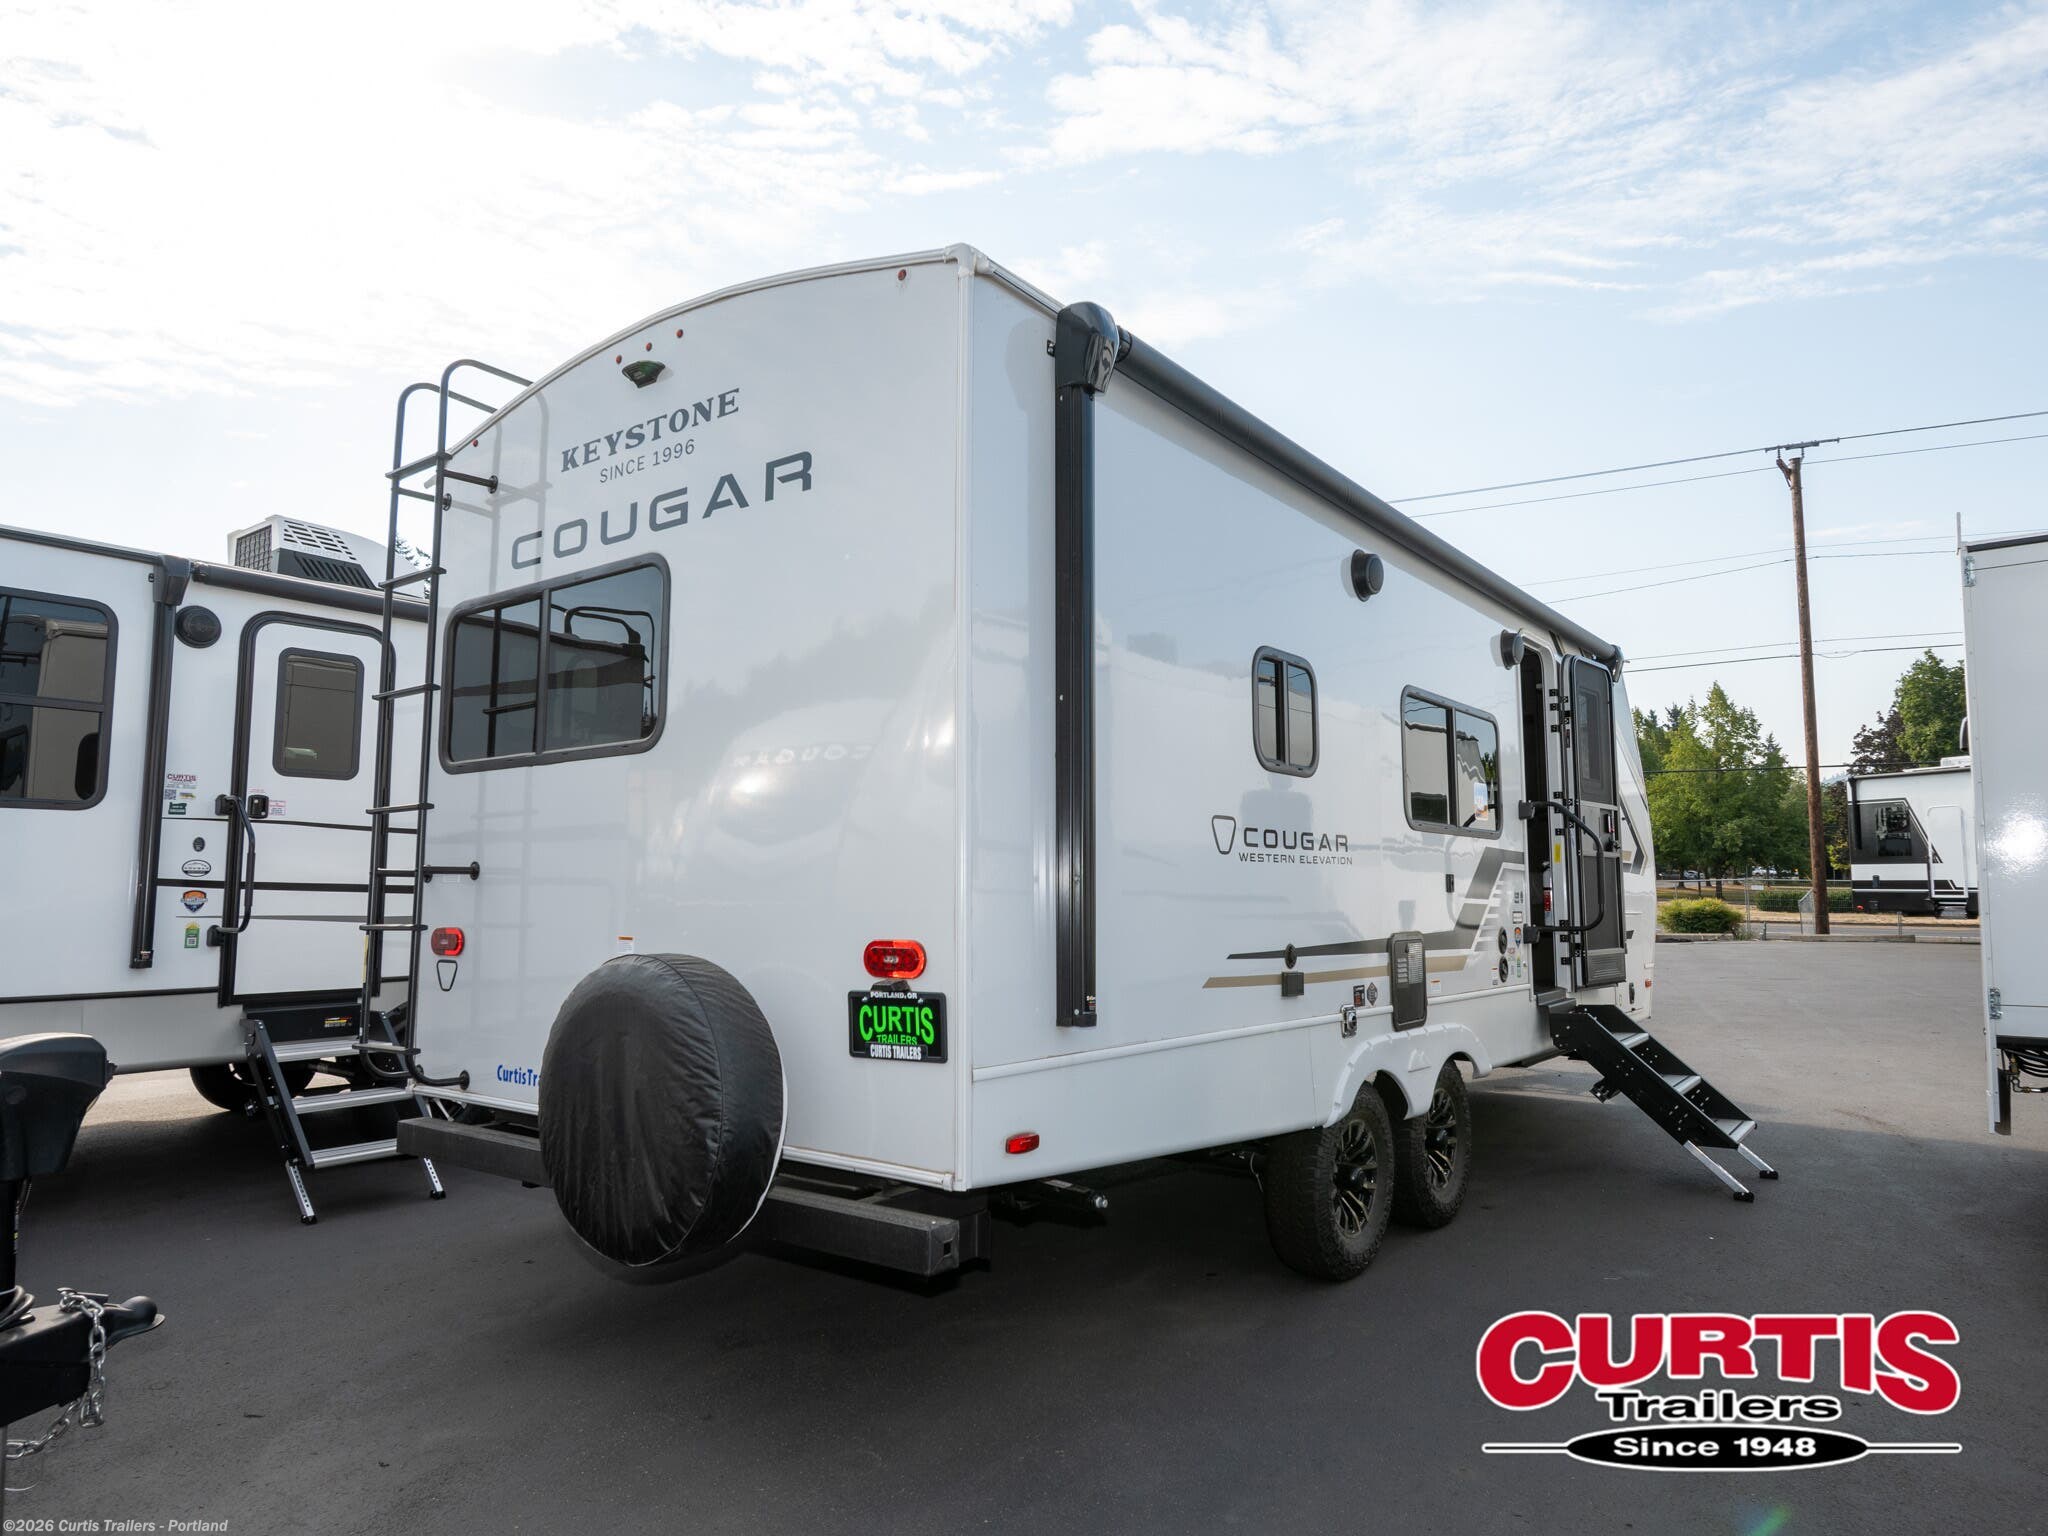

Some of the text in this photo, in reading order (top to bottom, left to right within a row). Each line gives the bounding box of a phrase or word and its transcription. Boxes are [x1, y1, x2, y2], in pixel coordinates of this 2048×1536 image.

[561, 388, 740, 472] KEYSTONE
[599, 438, 695, 484] SINCE 1996
[511, 450, 813, 570] COUGAR
[1243, 827, 1348, 852] COUGAR
[1239, 852, 1352, 865] WESTERN ELEVATION
[870, 991, 918, 1000] PORTLAND, OR
[859, 1004, 934, 1045] CURTIS
[876, 1033, 918, 1046] TRAILERS
[870, 1044, 921, 1060] CURTIS TRAILERS
[497, 1064, 541, 1086] CurtisTr
